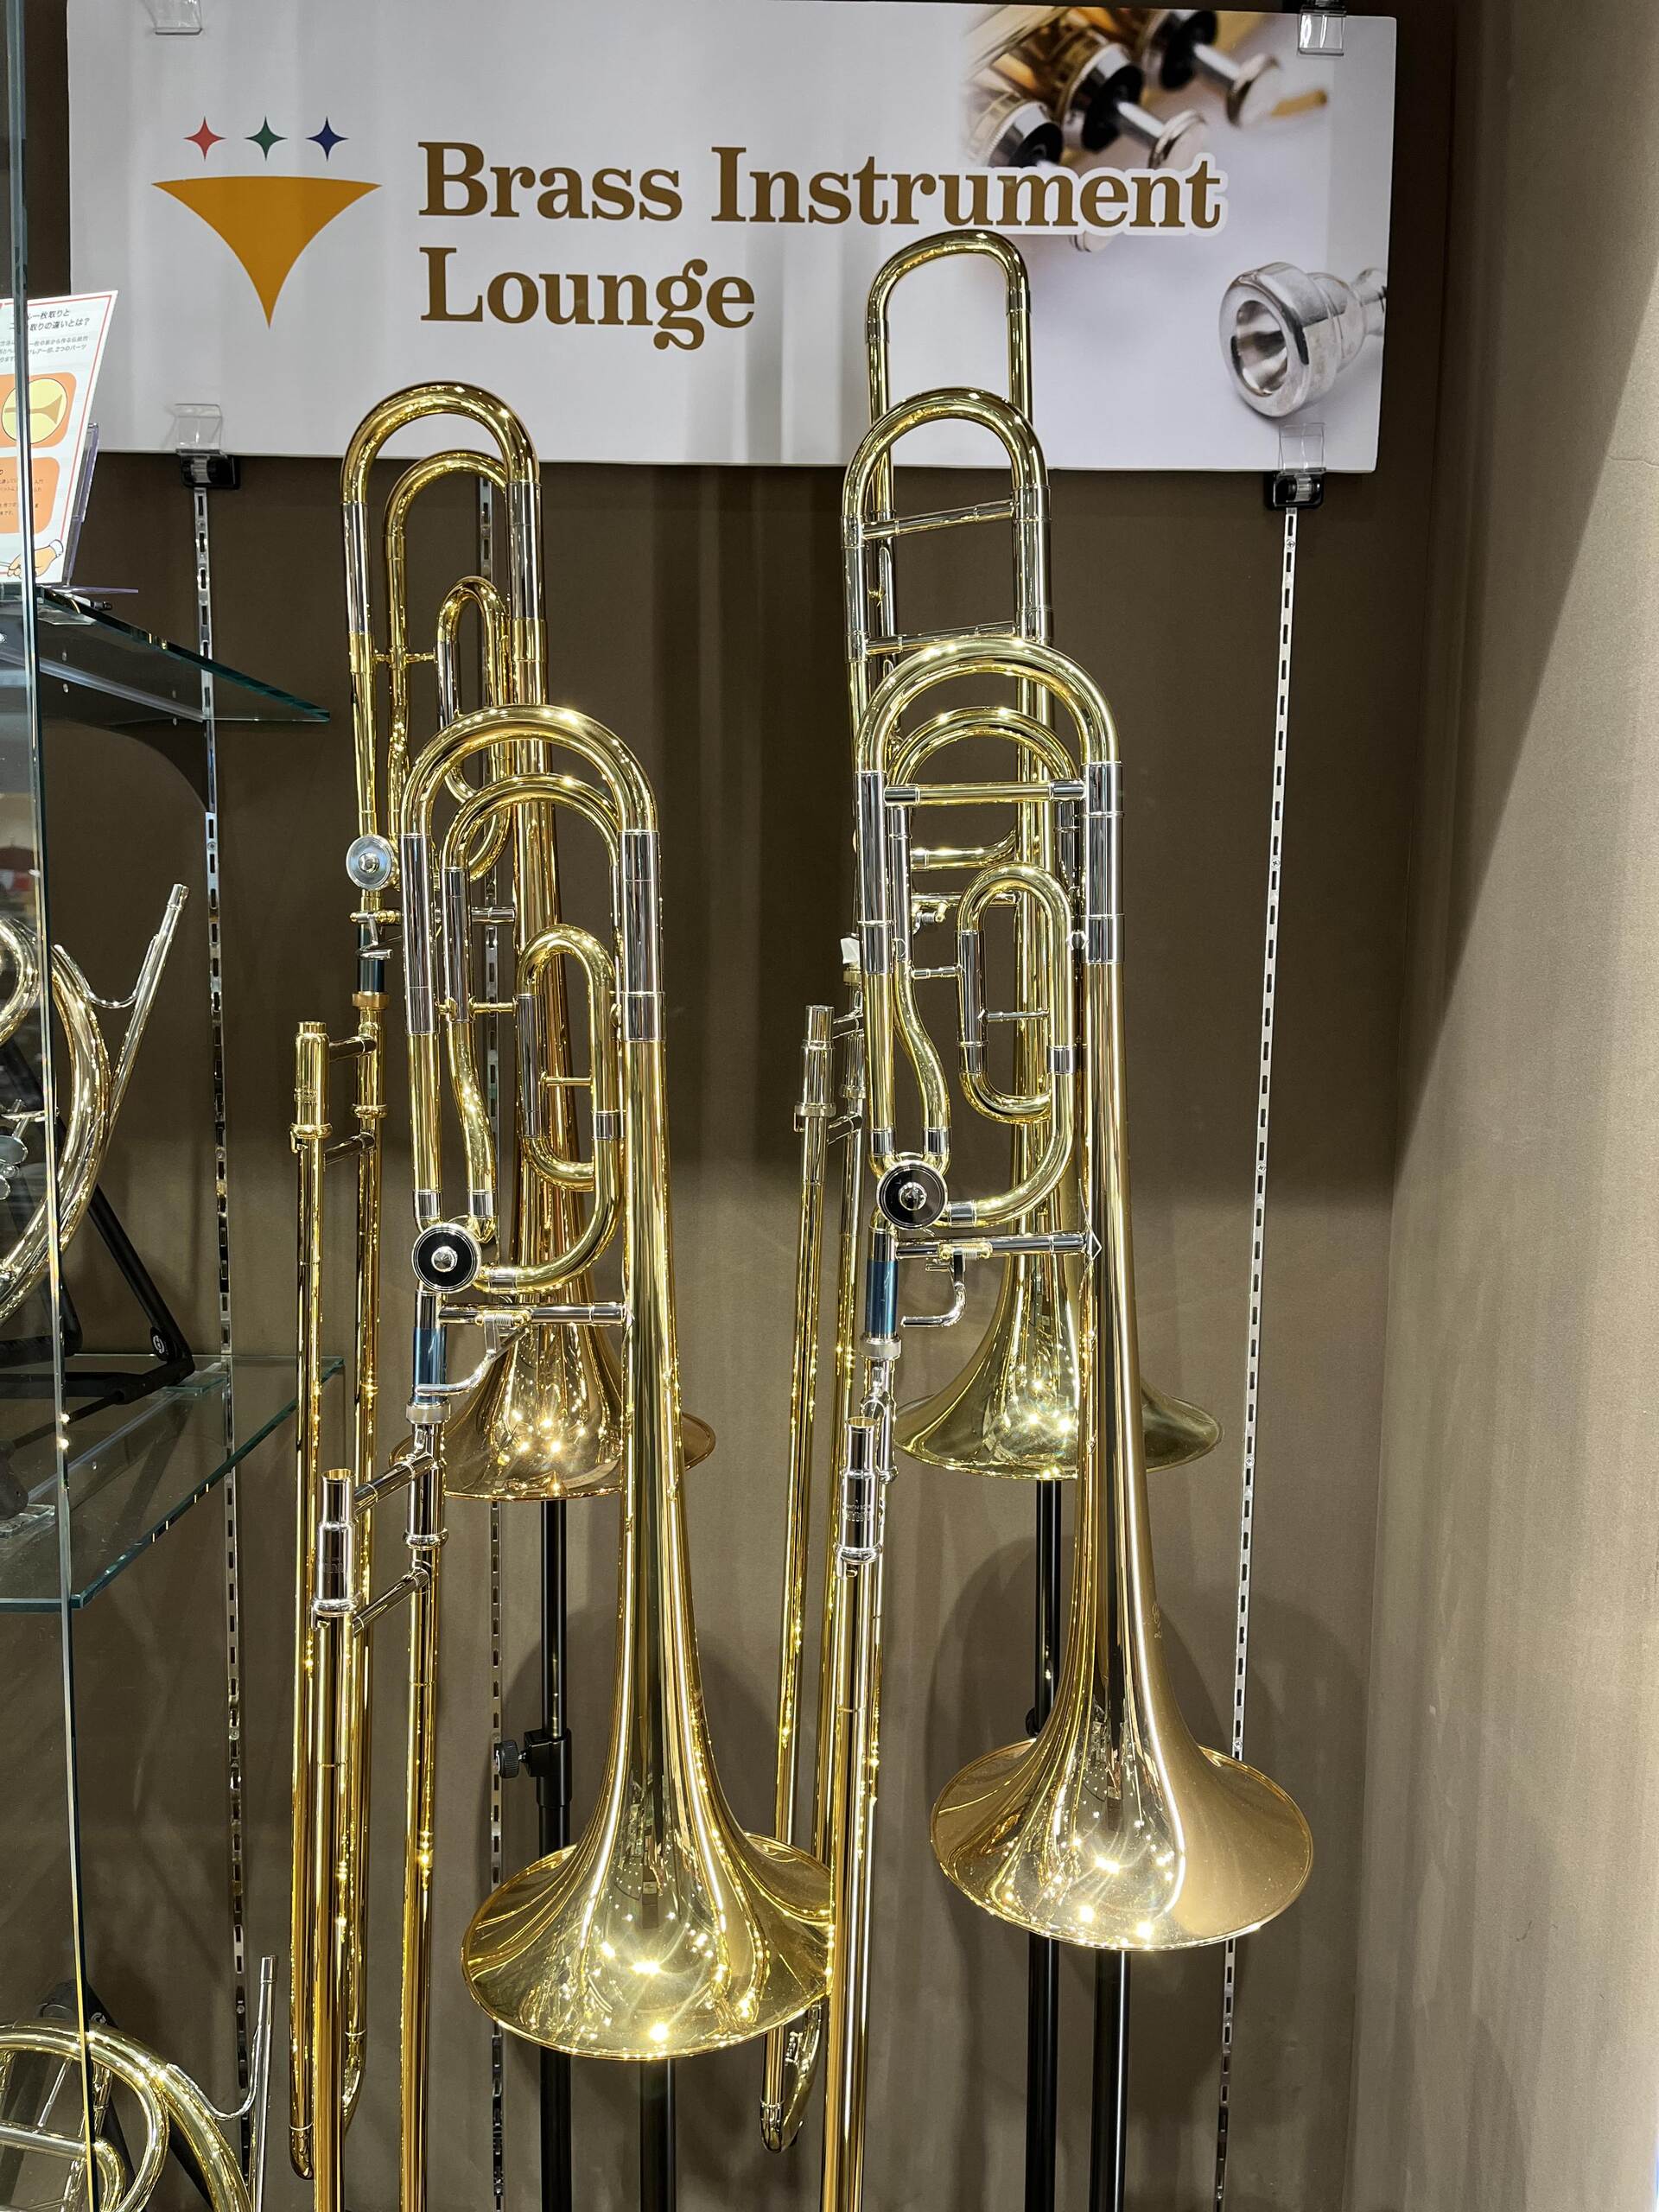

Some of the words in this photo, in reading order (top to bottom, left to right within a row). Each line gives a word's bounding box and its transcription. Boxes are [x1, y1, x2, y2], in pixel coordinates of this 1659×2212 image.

[418, 142, 683, 221] Brass
[711, 147, 1221, 228] Instrument
[420, 247, 755, 351] Lounge
